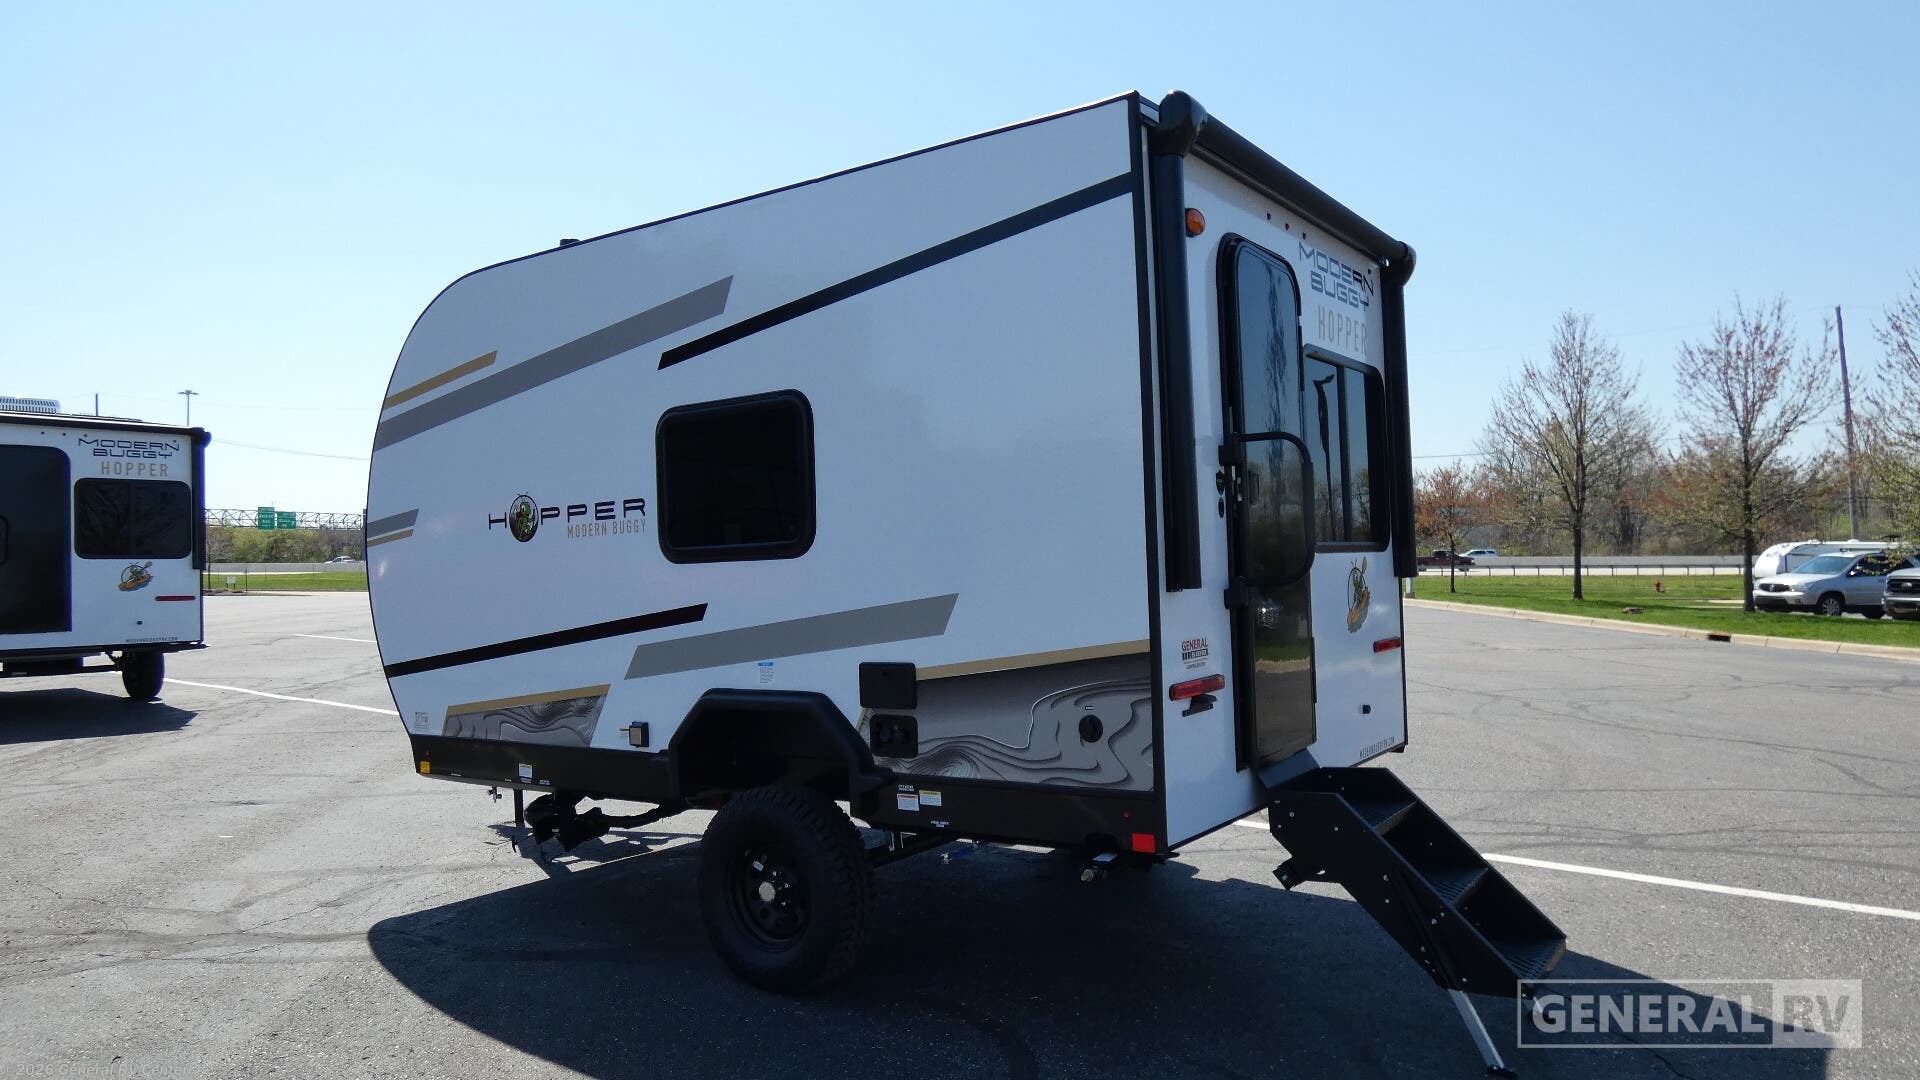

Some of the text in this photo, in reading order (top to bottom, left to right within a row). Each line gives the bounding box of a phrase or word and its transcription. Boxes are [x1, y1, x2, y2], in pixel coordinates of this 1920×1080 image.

[1299, 241, 1374, 296] MODERN
[1311, 270, 1369, 311] BUGGY
[1318, 304, 1367, 355] HOPPER
[78, 438, 179, 451] MODERN
[93, 448, 172, 459] BUGGY
[101, 461, 168, 477] HOPPER
[567, 519, 647, 539] MODERN BUGGY
[1182, 637, 1208, 652] GENERAL
